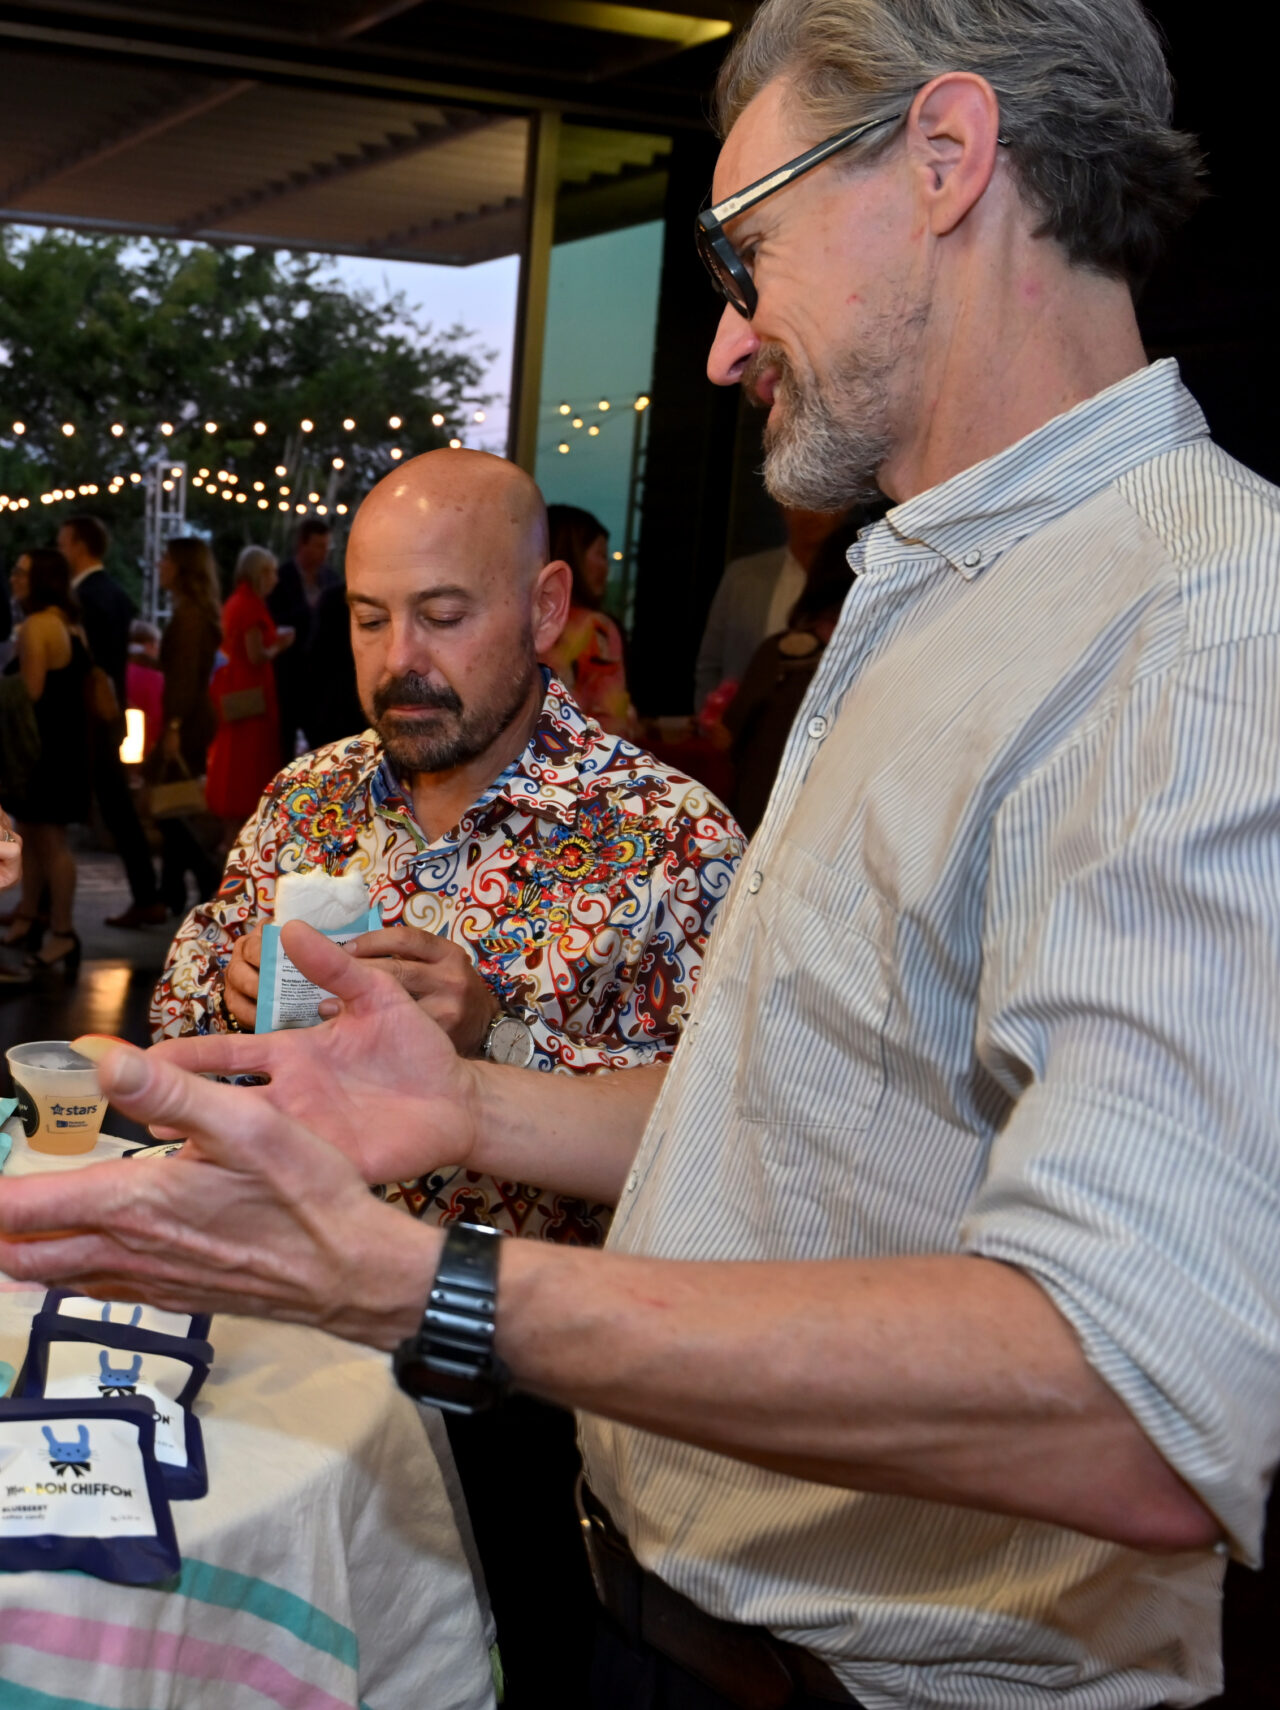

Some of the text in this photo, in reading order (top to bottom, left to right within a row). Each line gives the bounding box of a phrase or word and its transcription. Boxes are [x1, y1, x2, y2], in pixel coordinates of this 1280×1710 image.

[66, 1104, 97, 1116] stars
[36, 1482, 67, 1496] BON
[71, 1482, 133, 1498] CHIFFON
[1, 1504, 48, 1513] BLUEBERRY
